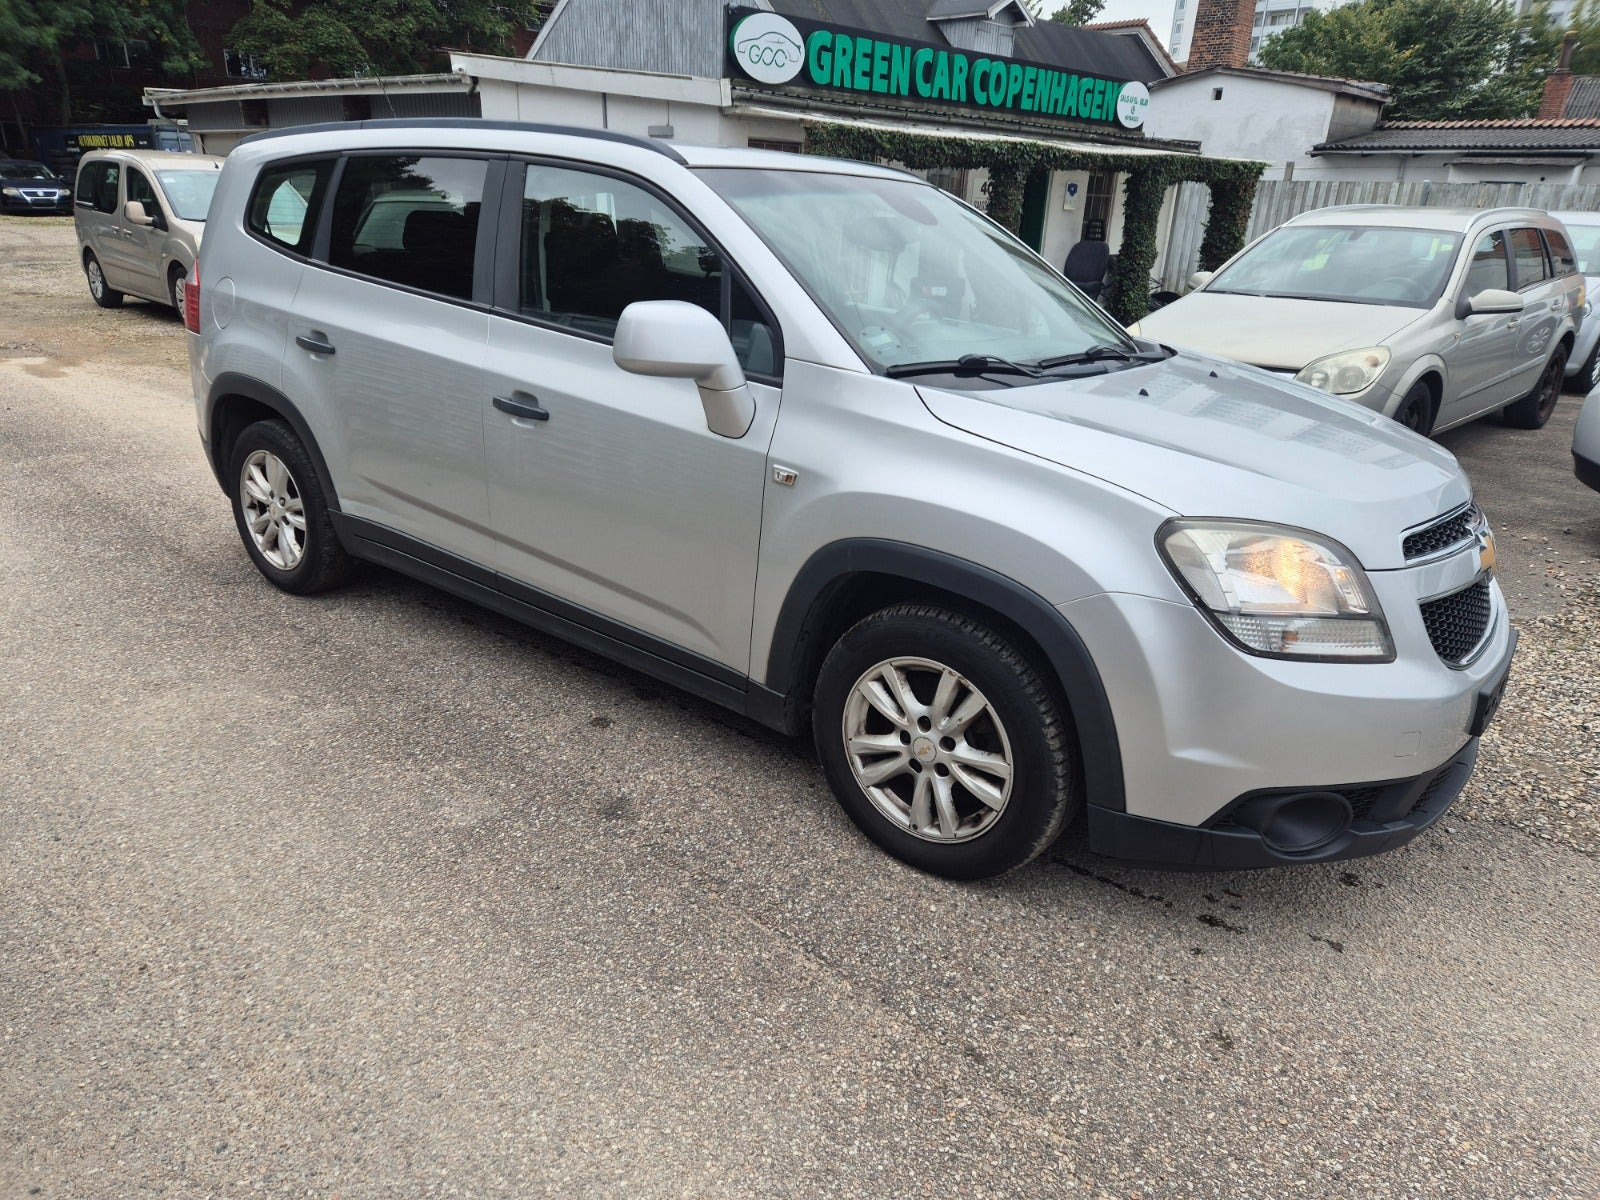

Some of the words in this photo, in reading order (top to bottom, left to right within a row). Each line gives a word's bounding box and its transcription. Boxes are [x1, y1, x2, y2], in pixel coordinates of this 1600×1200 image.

[806, 30, 911, 96] GREEN
[913, 48, 968, 102] CAR
[971, 58, 1118, 121] COPENHAGEN
